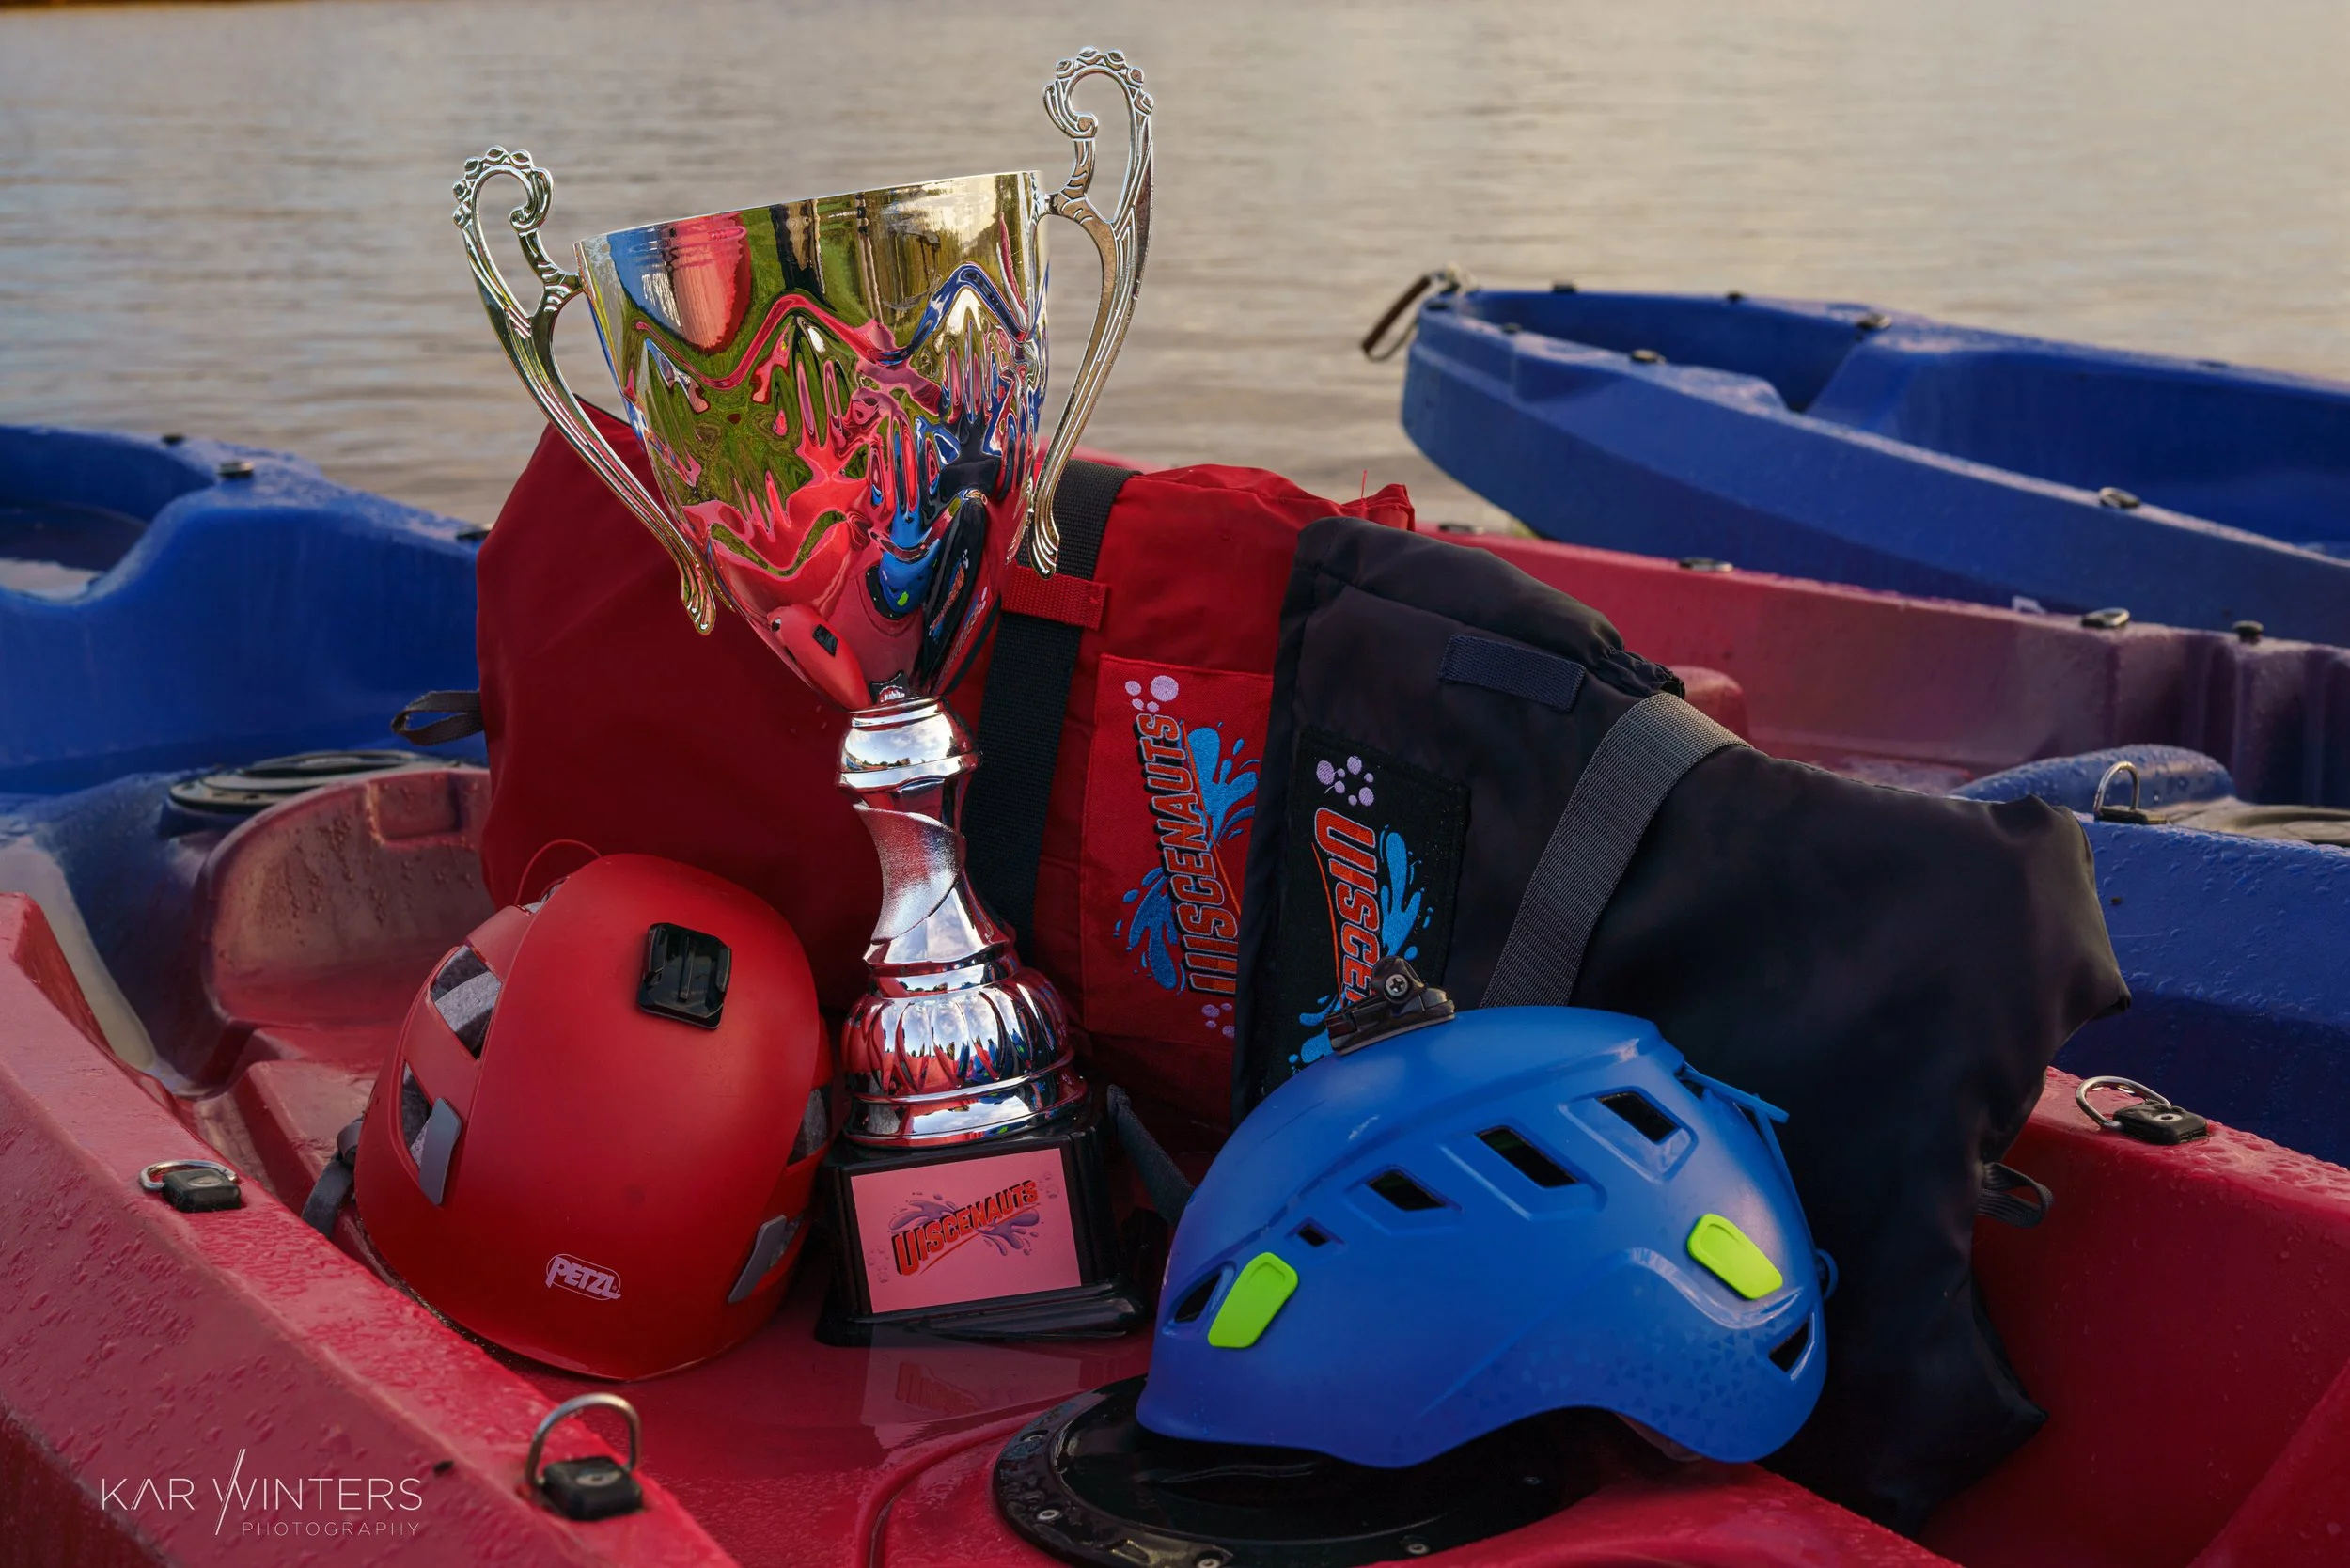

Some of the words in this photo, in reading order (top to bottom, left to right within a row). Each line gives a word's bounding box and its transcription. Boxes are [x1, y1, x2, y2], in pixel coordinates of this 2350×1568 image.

[1314, 807, 1380, 1003] UISCE
[545, 1255, 621, 1299] PETZL
[892, 1180, 1040, 1277] UISCENAUTS
